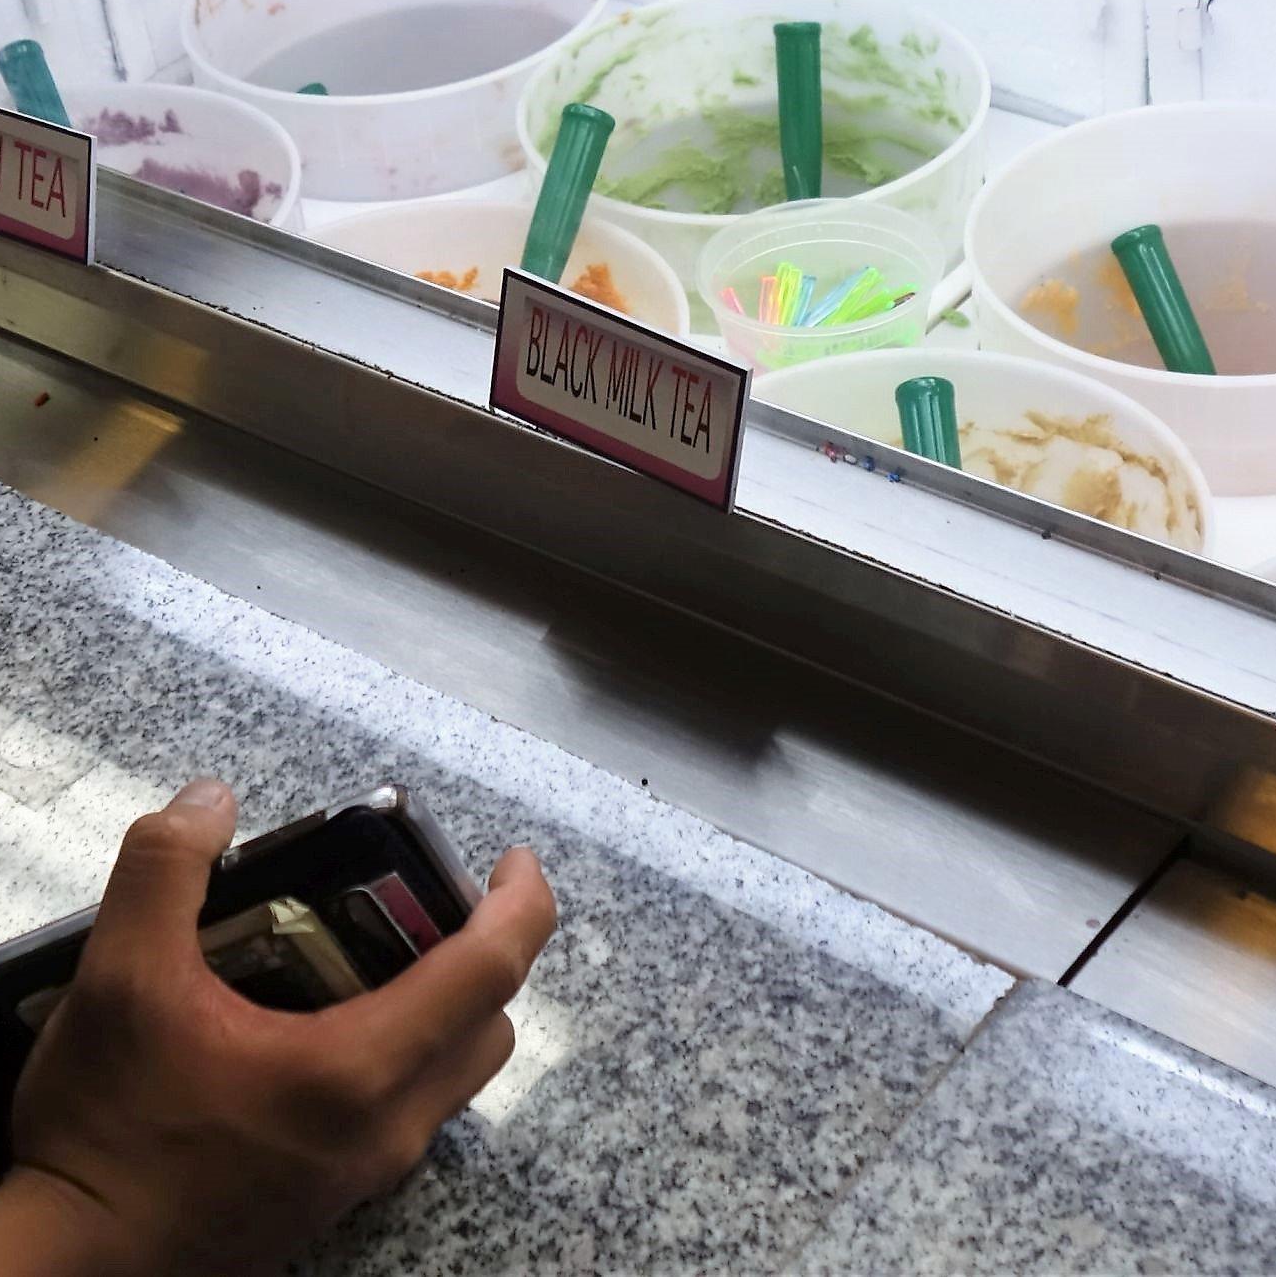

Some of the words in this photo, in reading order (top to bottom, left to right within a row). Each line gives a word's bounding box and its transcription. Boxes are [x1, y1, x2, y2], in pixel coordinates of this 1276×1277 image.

[14, 140, 67, 218] TEA
[525, 306, 604, 404] BLACK
[605, 339, 665, 431] MILK
[669, 363, 714, 454] TEA
